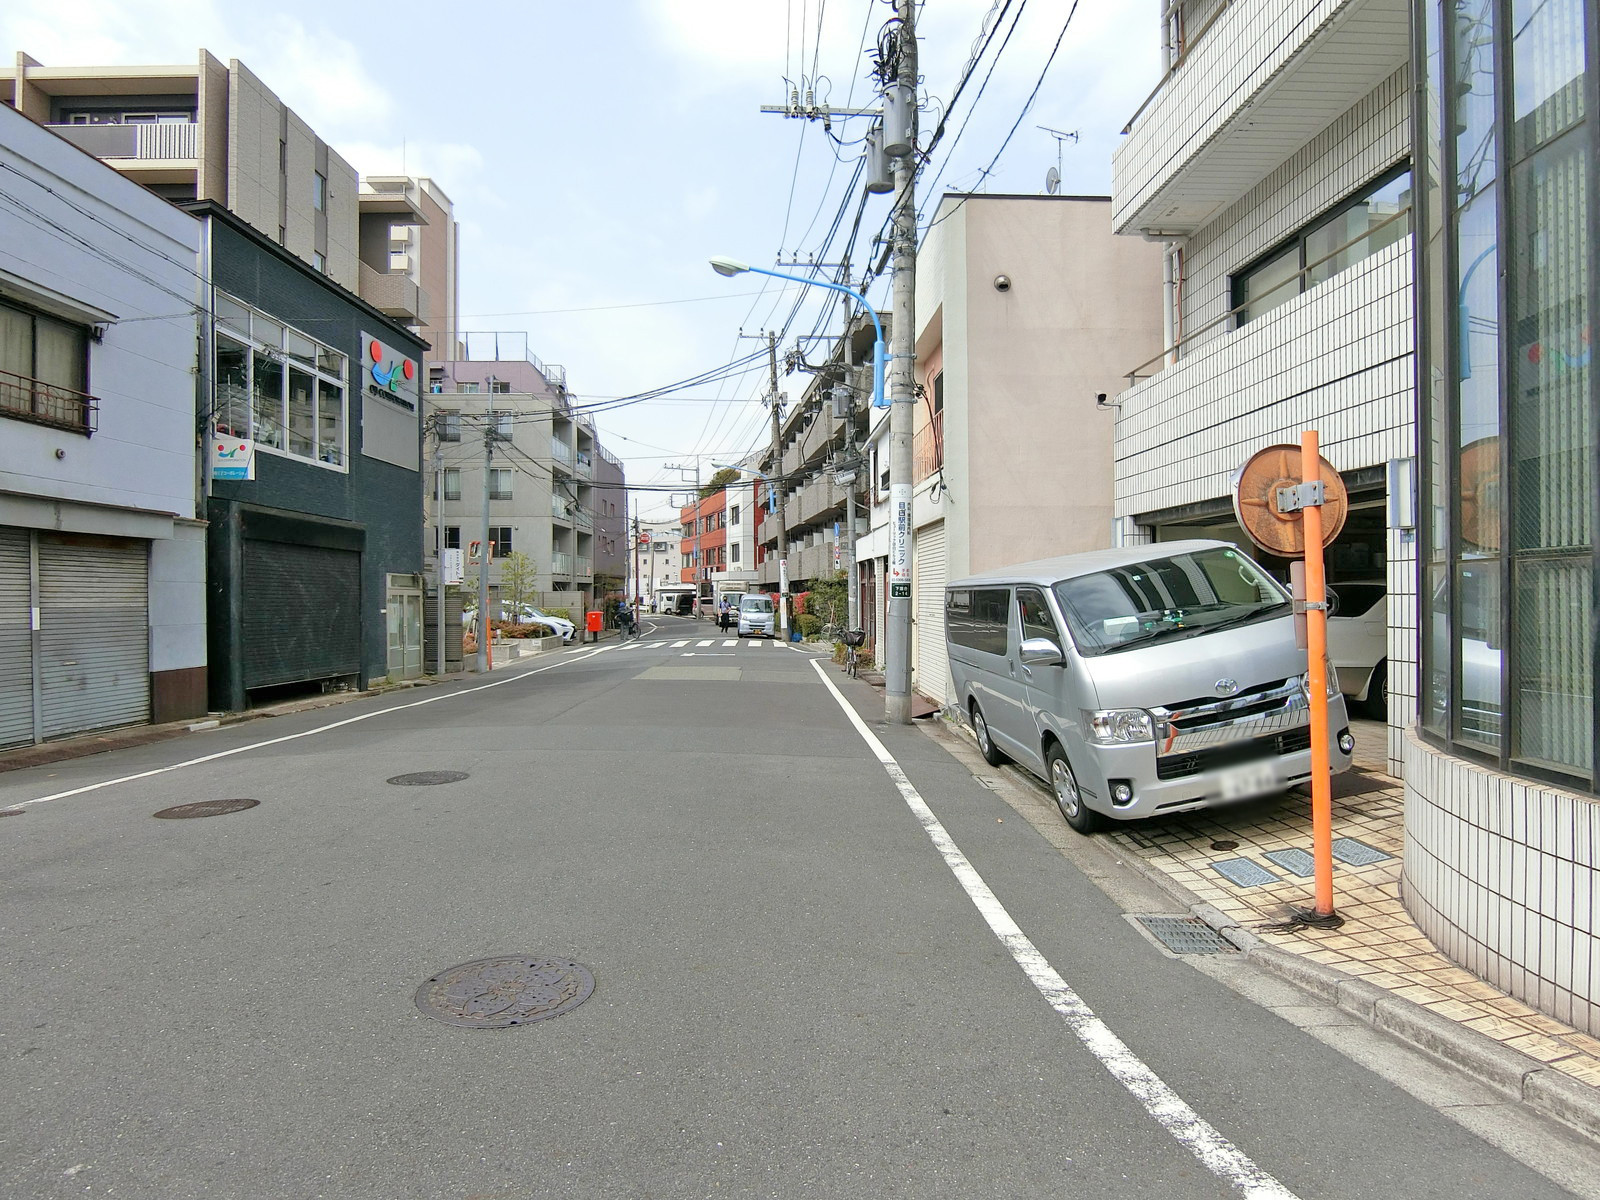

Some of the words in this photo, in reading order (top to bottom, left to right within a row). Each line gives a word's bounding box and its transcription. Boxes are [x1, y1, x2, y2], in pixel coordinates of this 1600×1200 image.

[898, 502, 906, 565] 目白駅前クリニック
